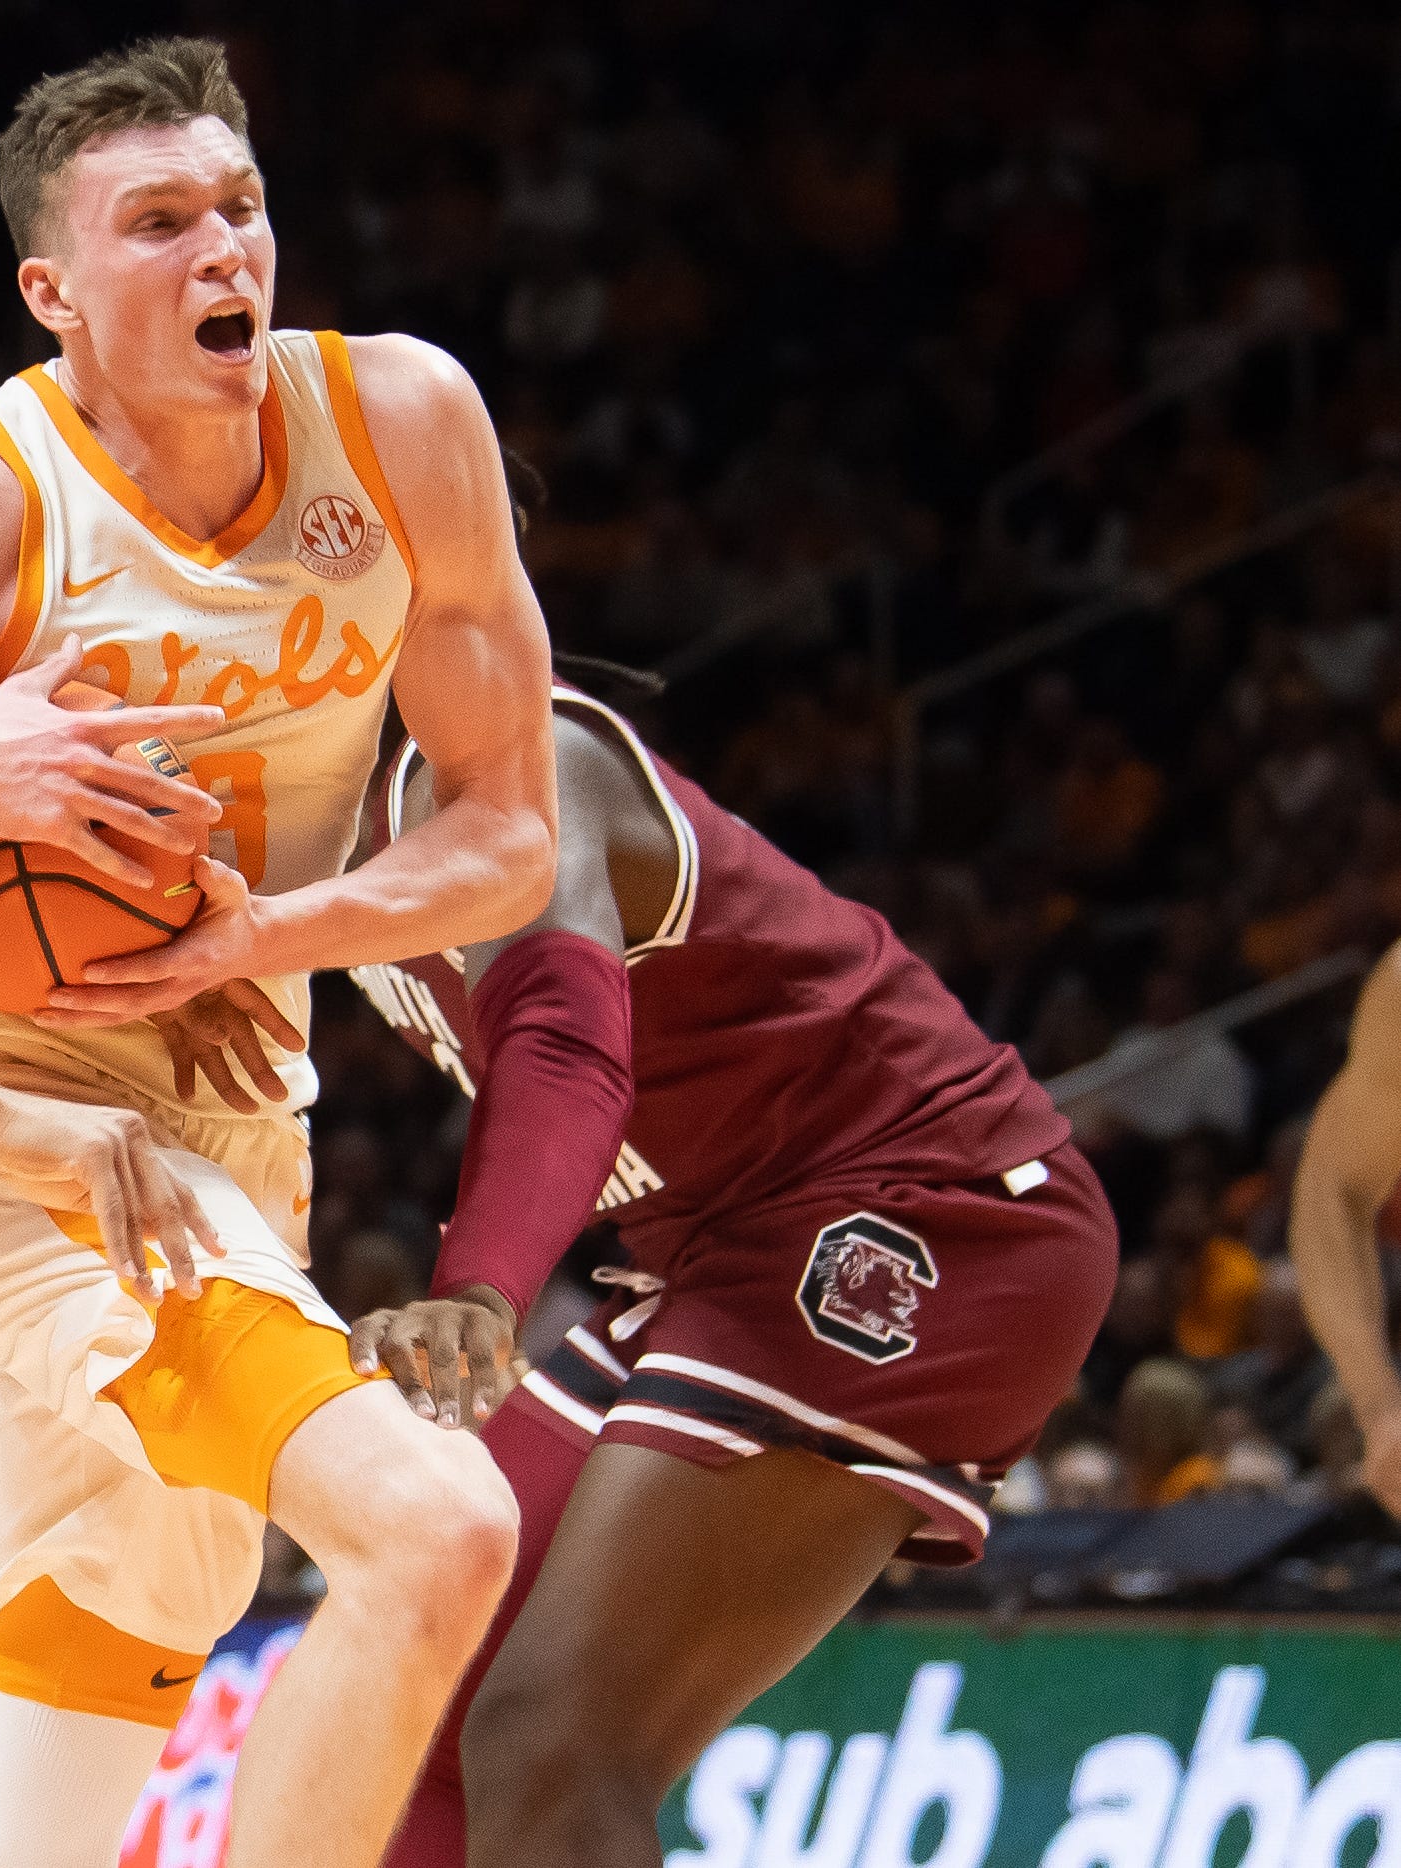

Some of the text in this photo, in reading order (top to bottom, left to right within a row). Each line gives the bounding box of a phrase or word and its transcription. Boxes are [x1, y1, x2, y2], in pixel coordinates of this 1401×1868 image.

[302, 498, 364, 558] SEC
[308, 541, 378, 578] GRADUATE
[83, 594, 402, 721] Vols
[663, 1660, 1003, 1868] sub
